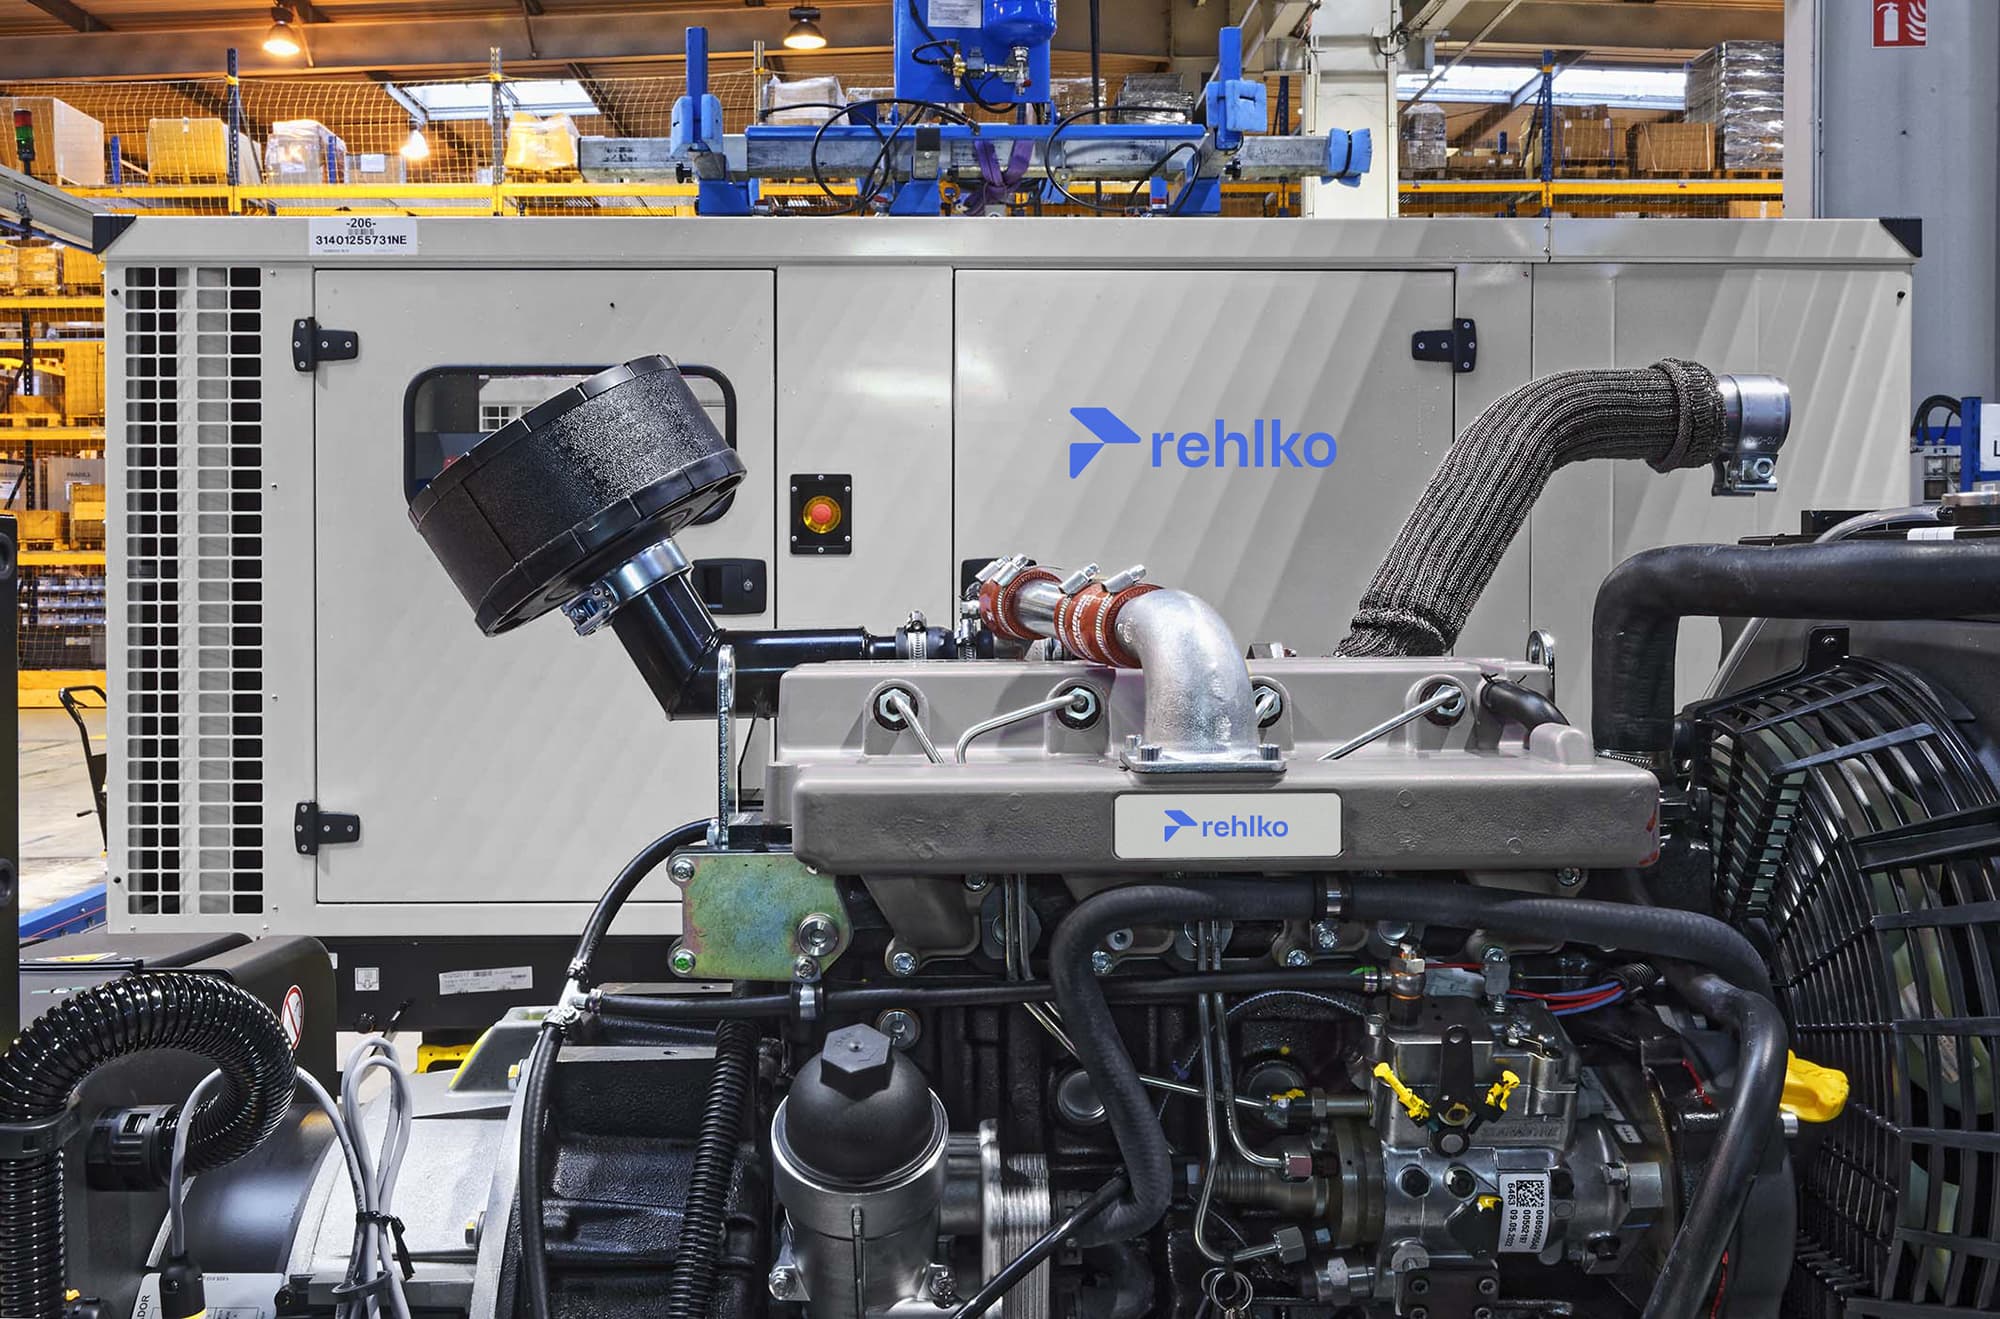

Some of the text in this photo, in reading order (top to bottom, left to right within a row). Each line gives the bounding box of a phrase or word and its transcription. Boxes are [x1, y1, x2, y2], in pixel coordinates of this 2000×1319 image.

[346, 218, 377, 228] -206-
[315, 235, 407, 245] 31401255731NE
[1151, 418, 1338, 468] rehlko
[1202, 815, 1289, 837] rehlko
[1507, 1182, 1516, 1206] 6463
[136, 1294, 151, 1319] DOR
